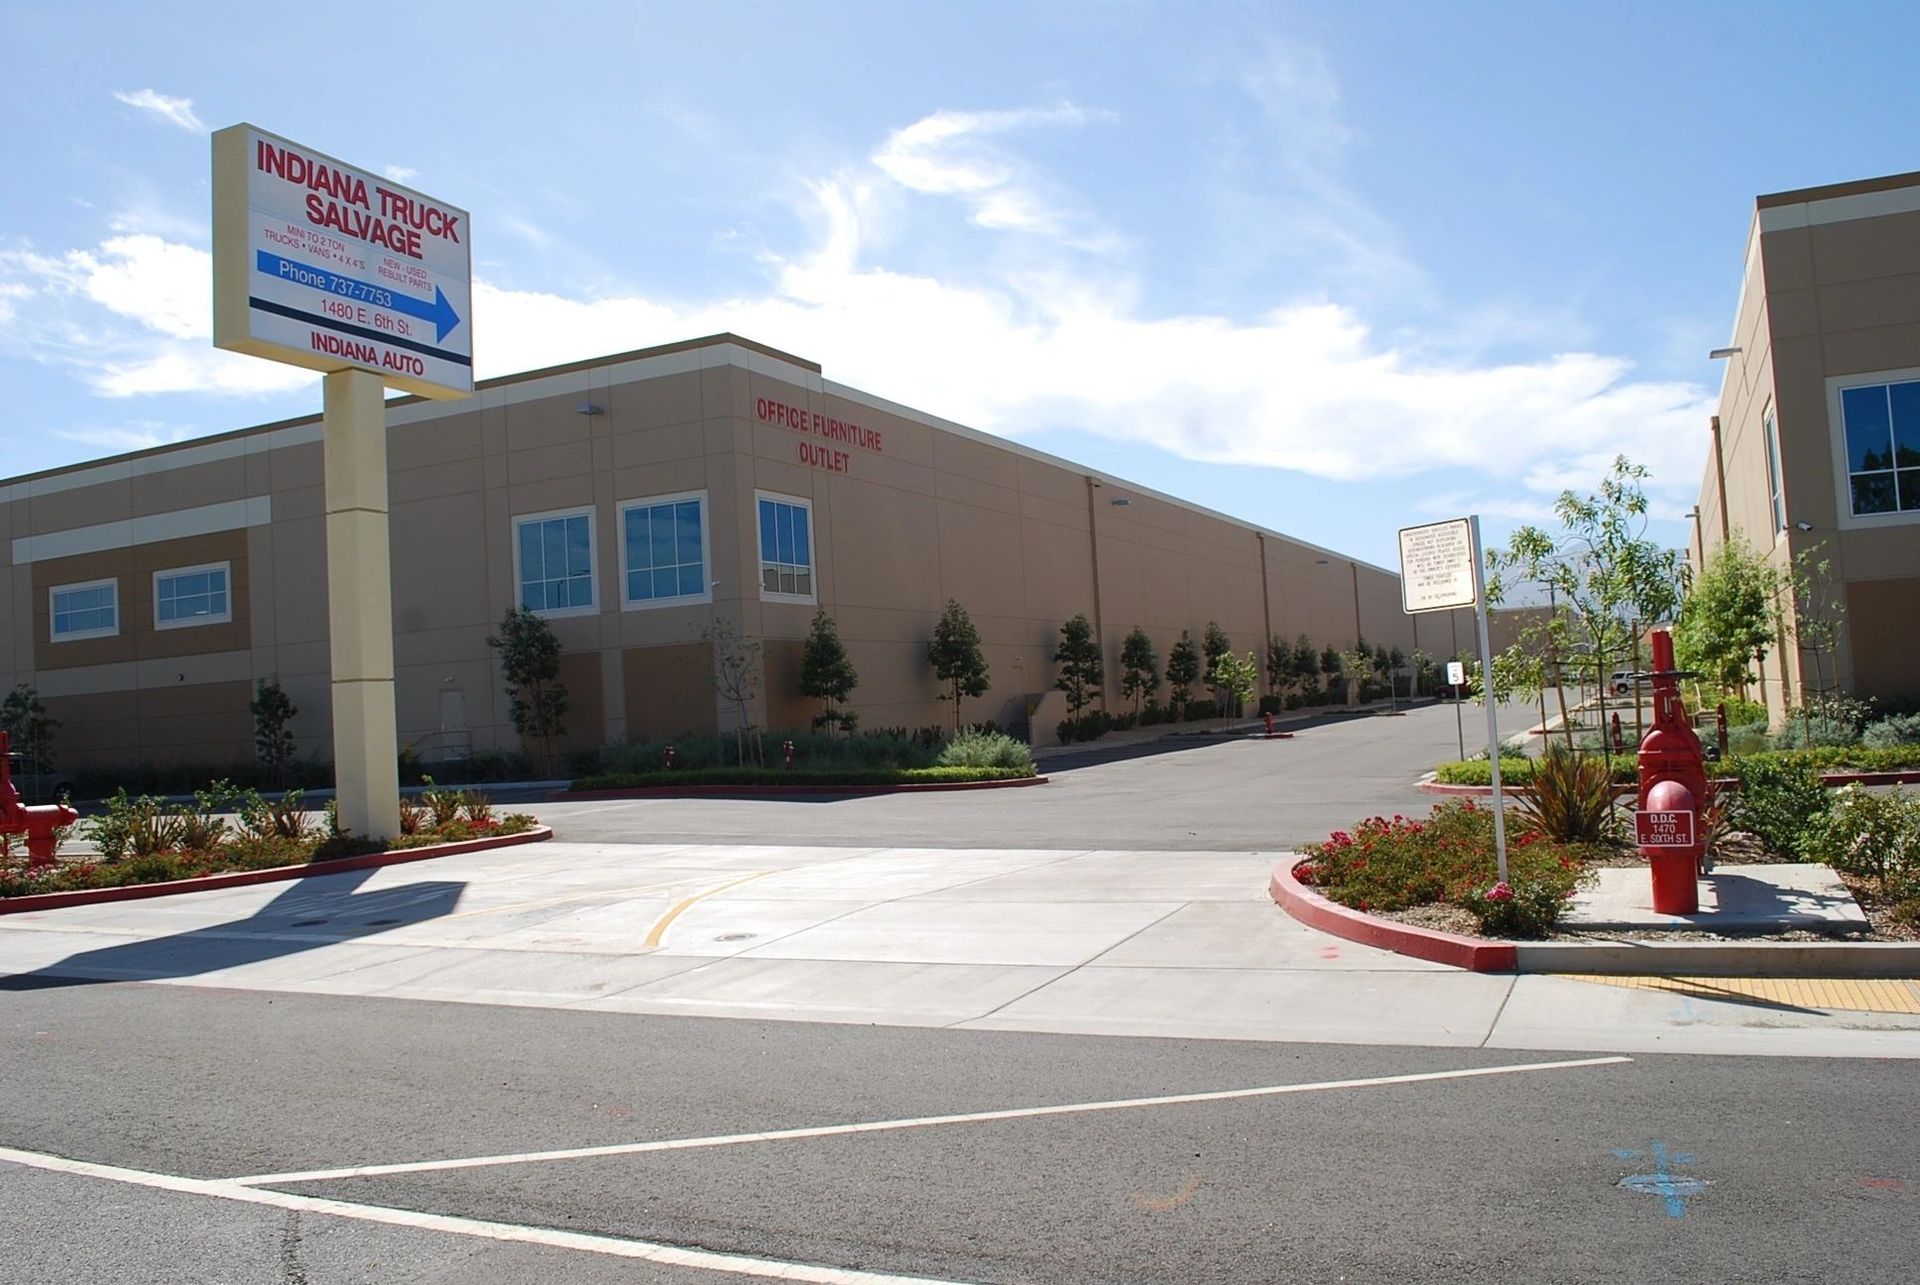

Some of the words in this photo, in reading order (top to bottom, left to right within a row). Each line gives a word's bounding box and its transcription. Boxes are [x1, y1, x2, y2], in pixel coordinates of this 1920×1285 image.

[257, 140, 370, 210] INDIANA
[376, 186, 460, 243] TRUCK
[287, 224, 306, 238] MINI
[307, 231, 319, 243] TO
[320, 235, 327, 246] 2
[328, 238, 345, 252] TON
[305, 193, 423, 260] SALVAGE
[264, 228, 299, 249] TRUCKS
[308, 243, 331, 259] VANS
[279, 260, 326, 288] Phone
[330, 276, 392, 307] 737-7753
[378, 266, 407, 284] REBUILT
[409, 277, 432, 292] PARTS
[383, 257, 400, 271] NEW
[406, 265, 427, 279] USED
[321, 299, 353, 320] 1480
[357, 310, 370, 325] E.
[375, 313, 395, 331] 6th
[397, 320, 412, 337] St.
[311, 331, 379, 365] INDIANA
[382, 350, 424, 376] AUTO
[757, 398, 808, 432] OFFICE
[812, 413, 882, 451] FURNITURE
[799, 442, 850, 473] OUTLET
[1650, 814, 1678, 823] D.D.C.
[1653, 824, 1676, 833] 1470
[1650, 834, 1674, 843] SIXTH
